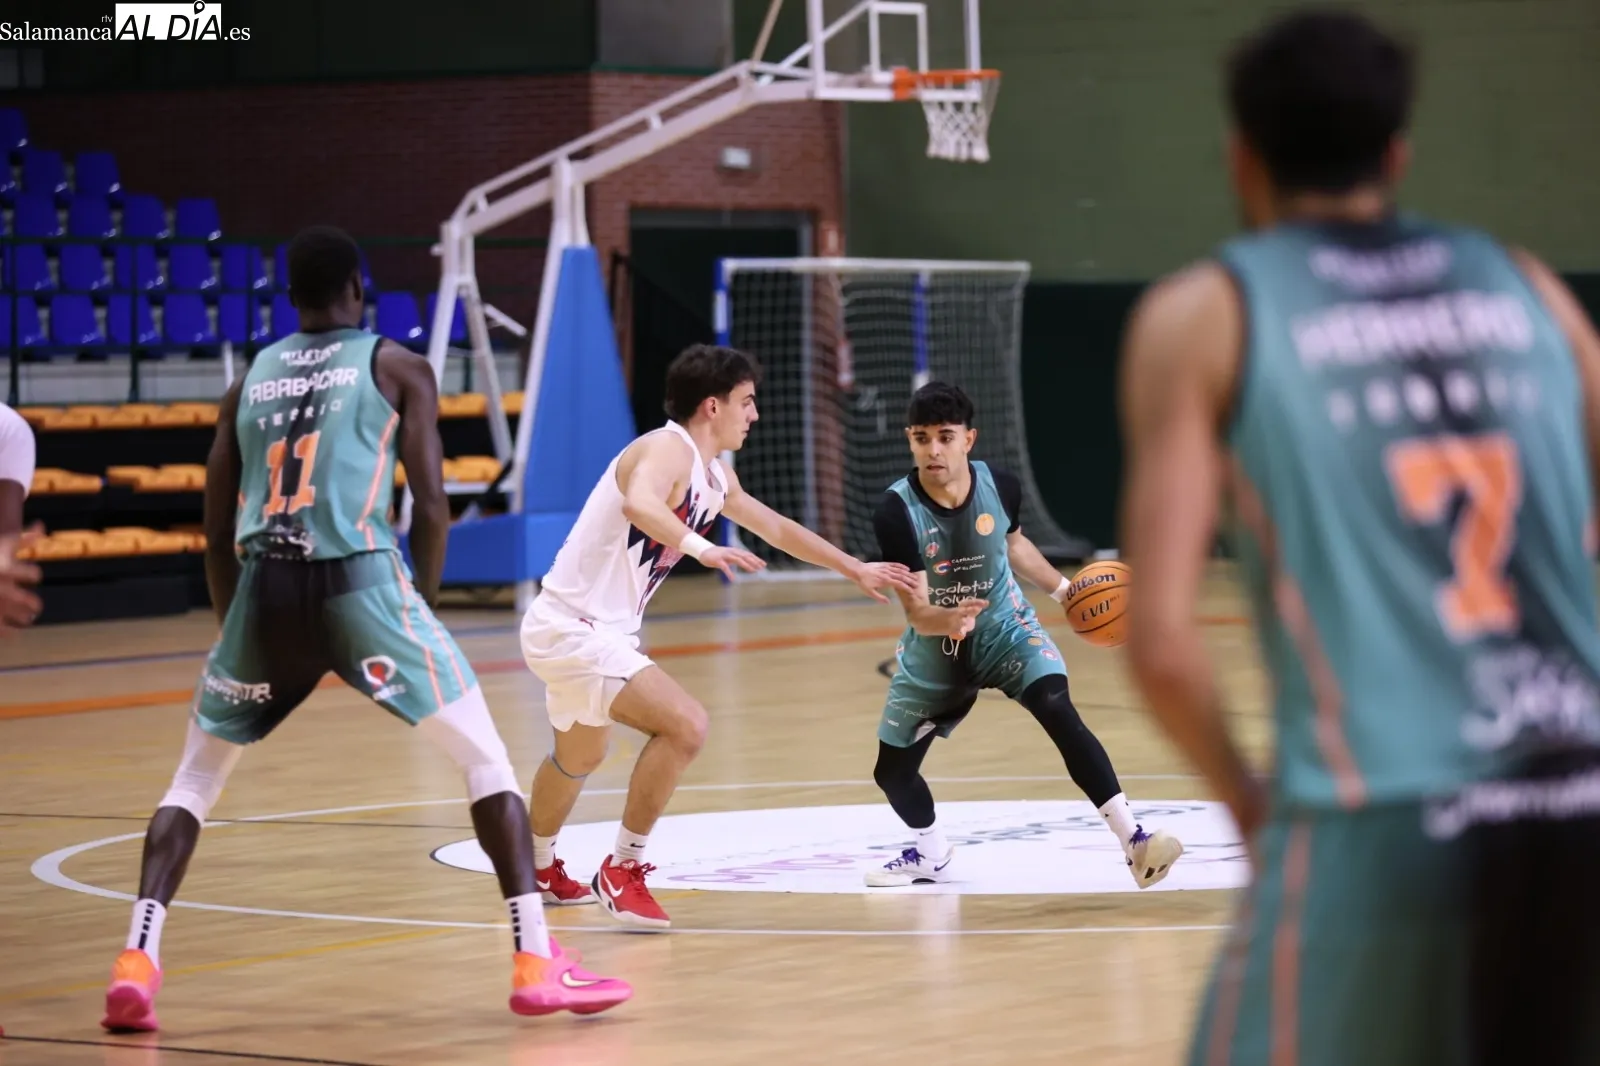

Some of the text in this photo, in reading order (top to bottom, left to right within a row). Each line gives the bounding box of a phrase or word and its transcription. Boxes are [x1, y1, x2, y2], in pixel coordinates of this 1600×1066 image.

[248, 367, 359, 406] ABABACAR
[262, 430, 321, 522] 11
[1385, 434, 1522, 643] 7
[928, 578, 994, 595] ecoletas
[1066, 573, 1116, 601] Wilson
